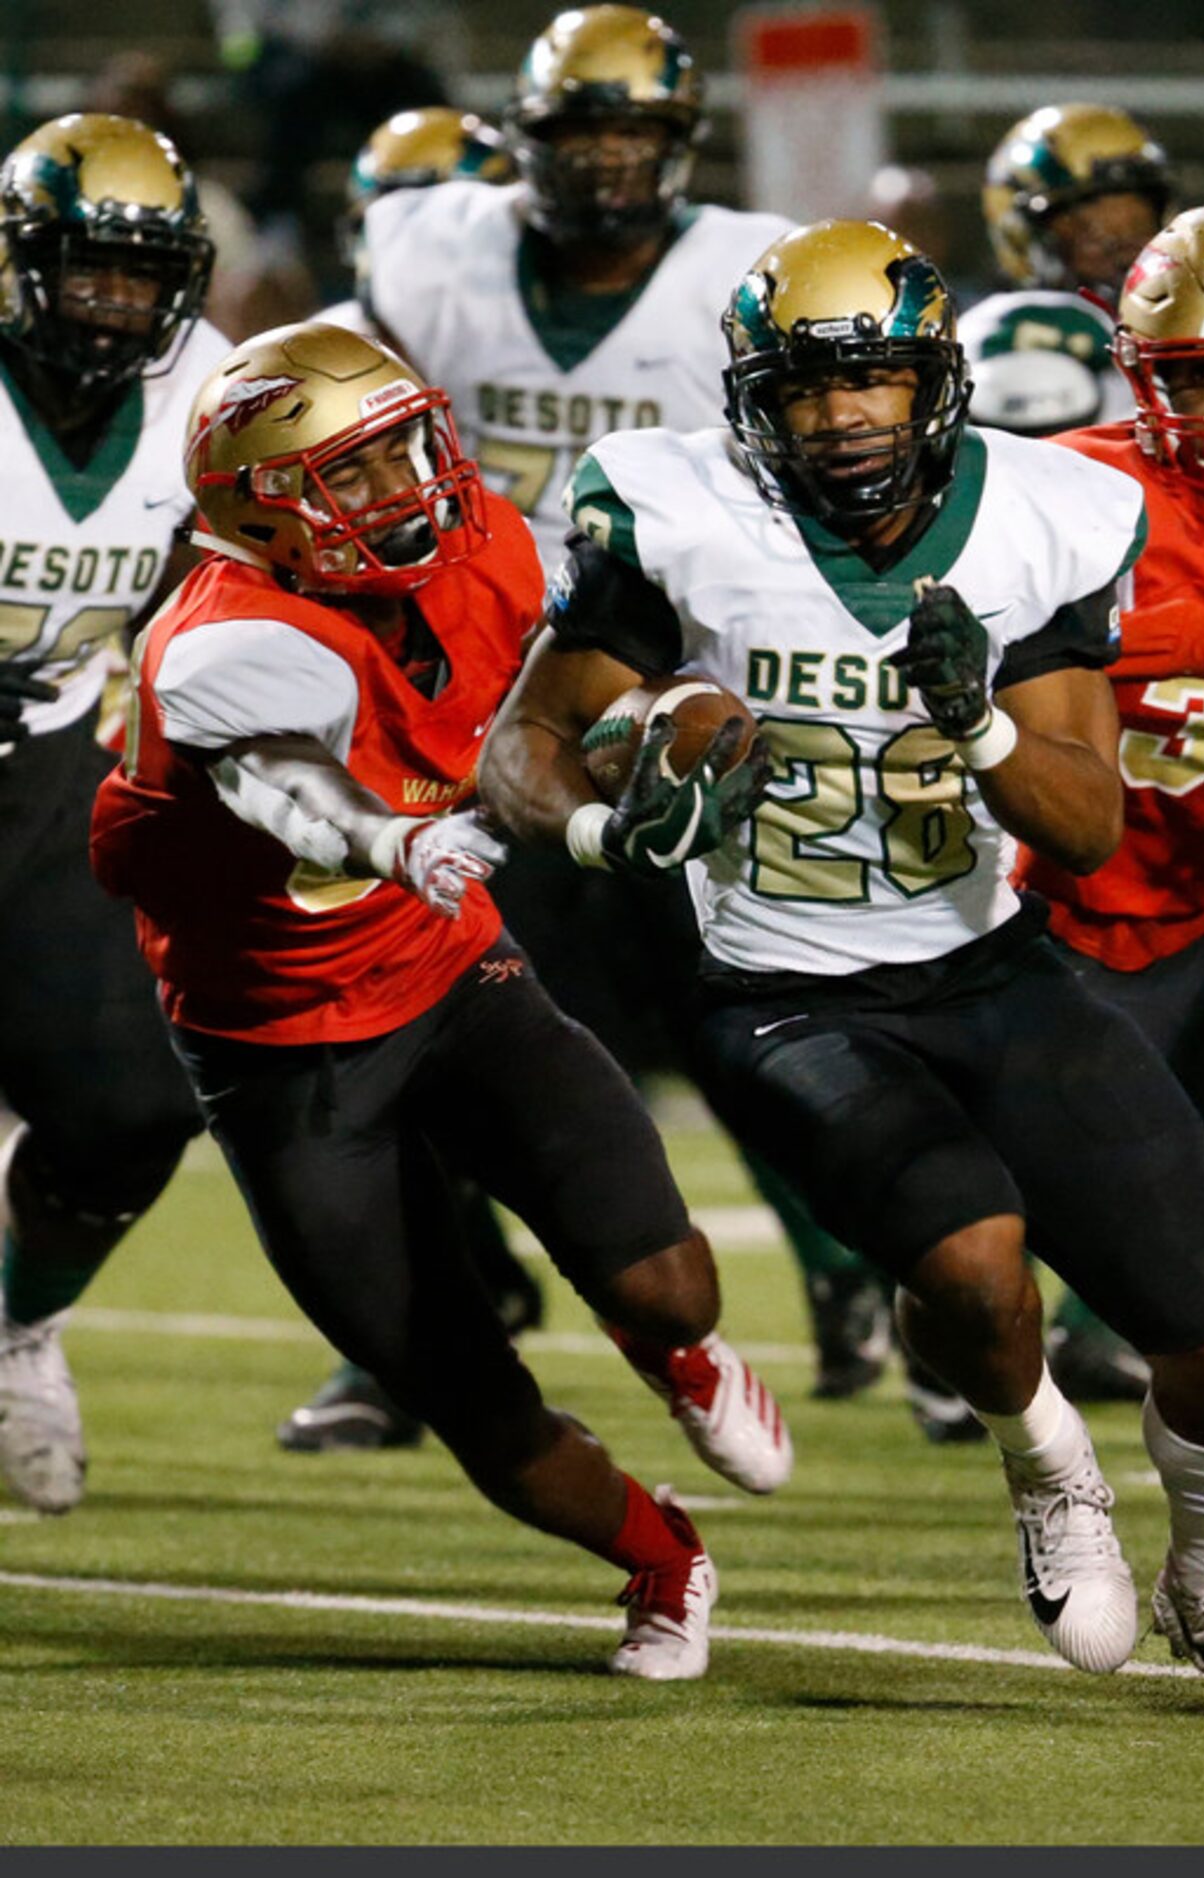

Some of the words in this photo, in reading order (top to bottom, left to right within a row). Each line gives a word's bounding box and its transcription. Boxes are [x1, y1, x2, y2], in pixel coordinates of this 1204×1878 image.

[476, 383, 661, 436] DESOTO
[0, 541, 159, 593] ESOTO
[750, 714, 977, 902] 28
